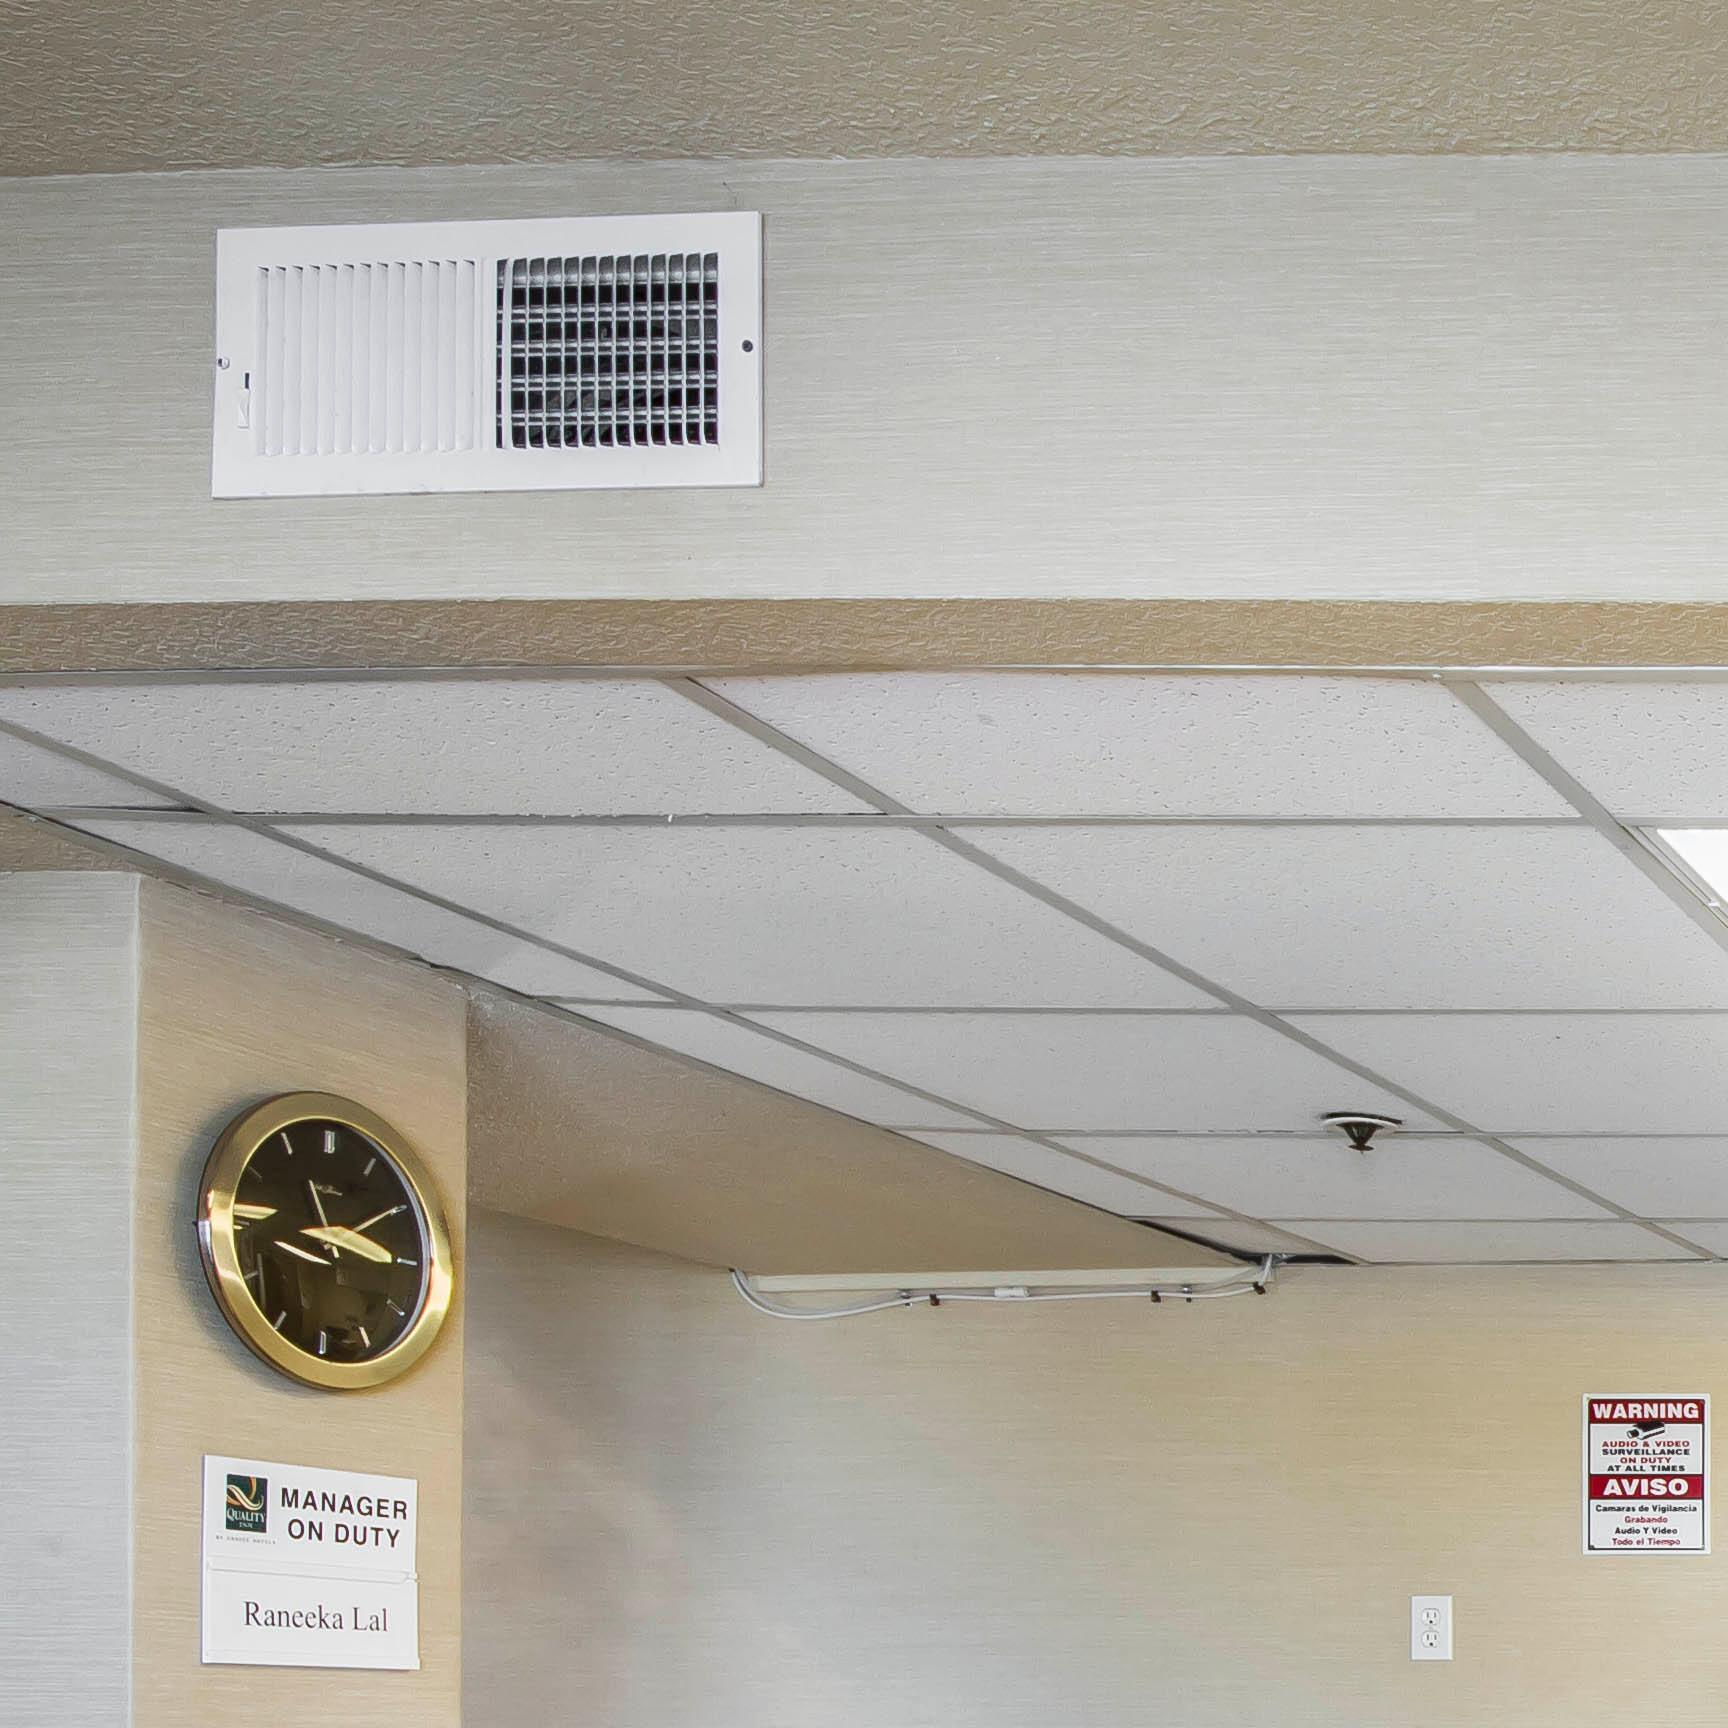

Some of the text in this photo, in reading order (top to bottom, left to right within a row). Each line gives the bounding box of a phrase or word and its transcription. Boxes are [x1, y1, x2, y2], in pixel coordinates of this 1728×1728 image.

[1592, 1403, 1699, 1419] WARNING
[1603, 1478, 1689, 1495] AVISO
[281, 1487, 407, 1520] MANAGER
[1595, 1504, 1697, 1513] Camaras de Vigilancia
[227, 1508, 266, 1523] QUALITY
[287, 1519, 400, 1548] ON DUTY
[1648, 1538, 1680, 1546] Tiempo
[244, 1600, 389, 1632] Raneeka Lal
